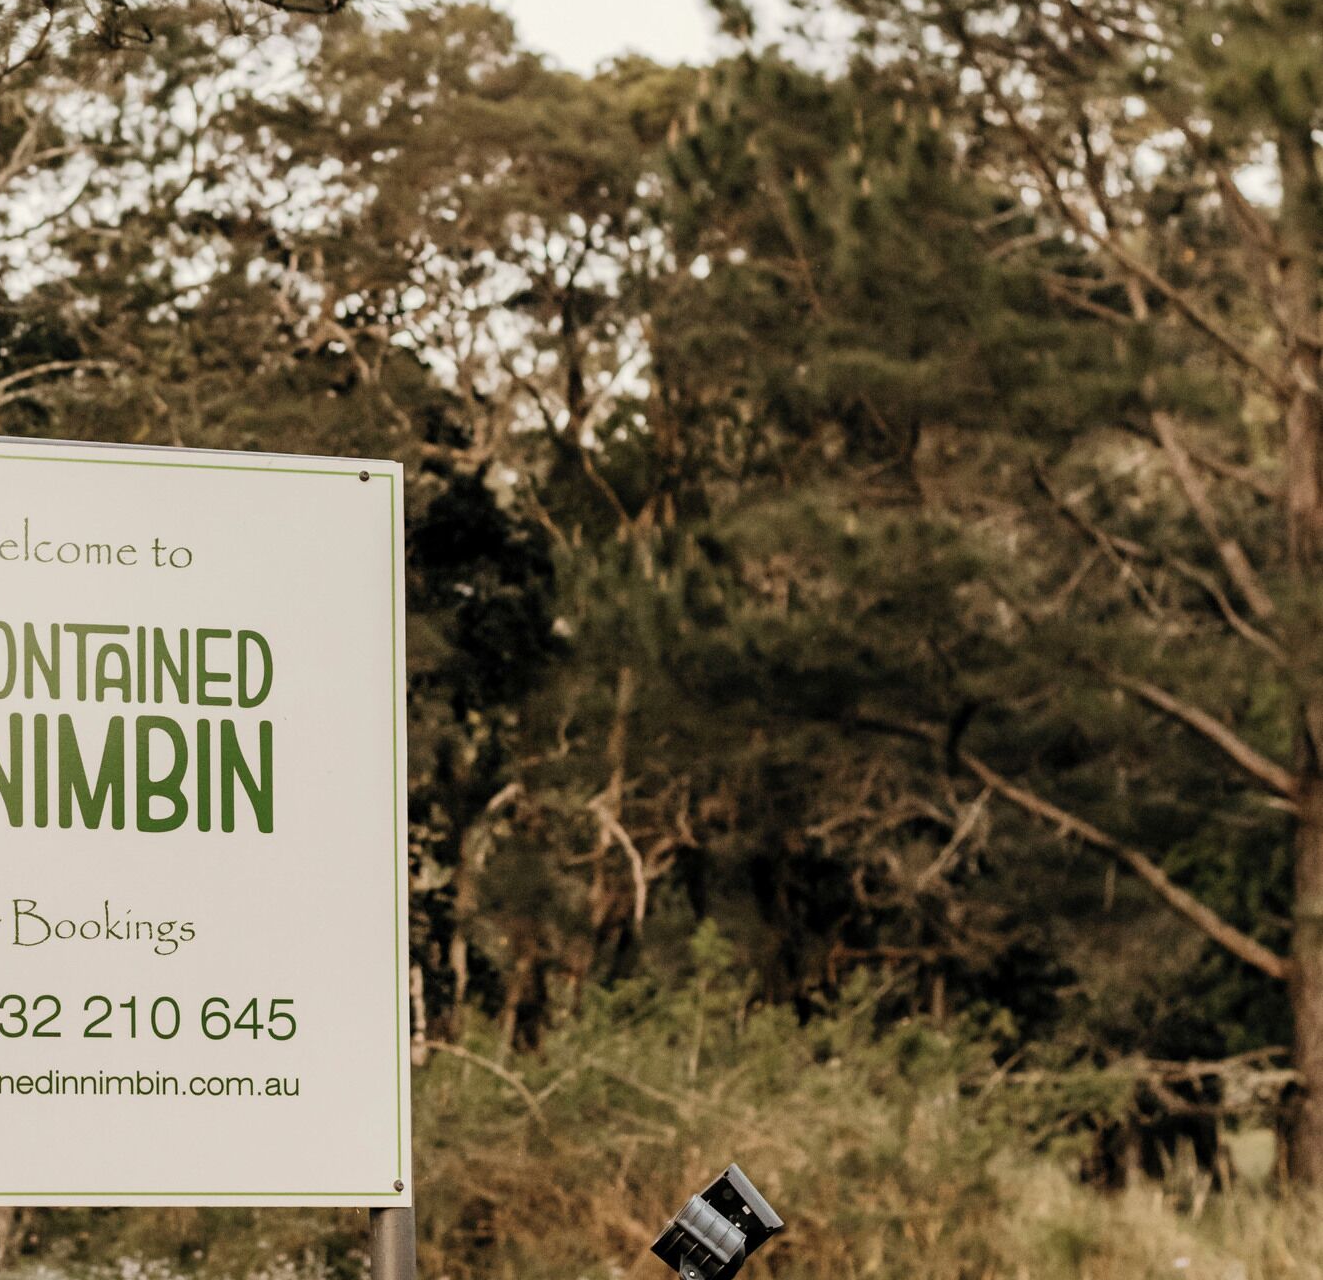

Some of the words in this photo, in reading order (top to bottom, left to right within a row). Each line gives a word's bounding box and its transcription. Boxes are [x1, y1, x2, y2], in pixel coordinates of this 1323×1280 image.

[150, 537, 193, 569] to
[11, 898, 196, 956] Bookings
[82, 994, 181, 1041] 210
[200, 996, 297, 1042] 645
